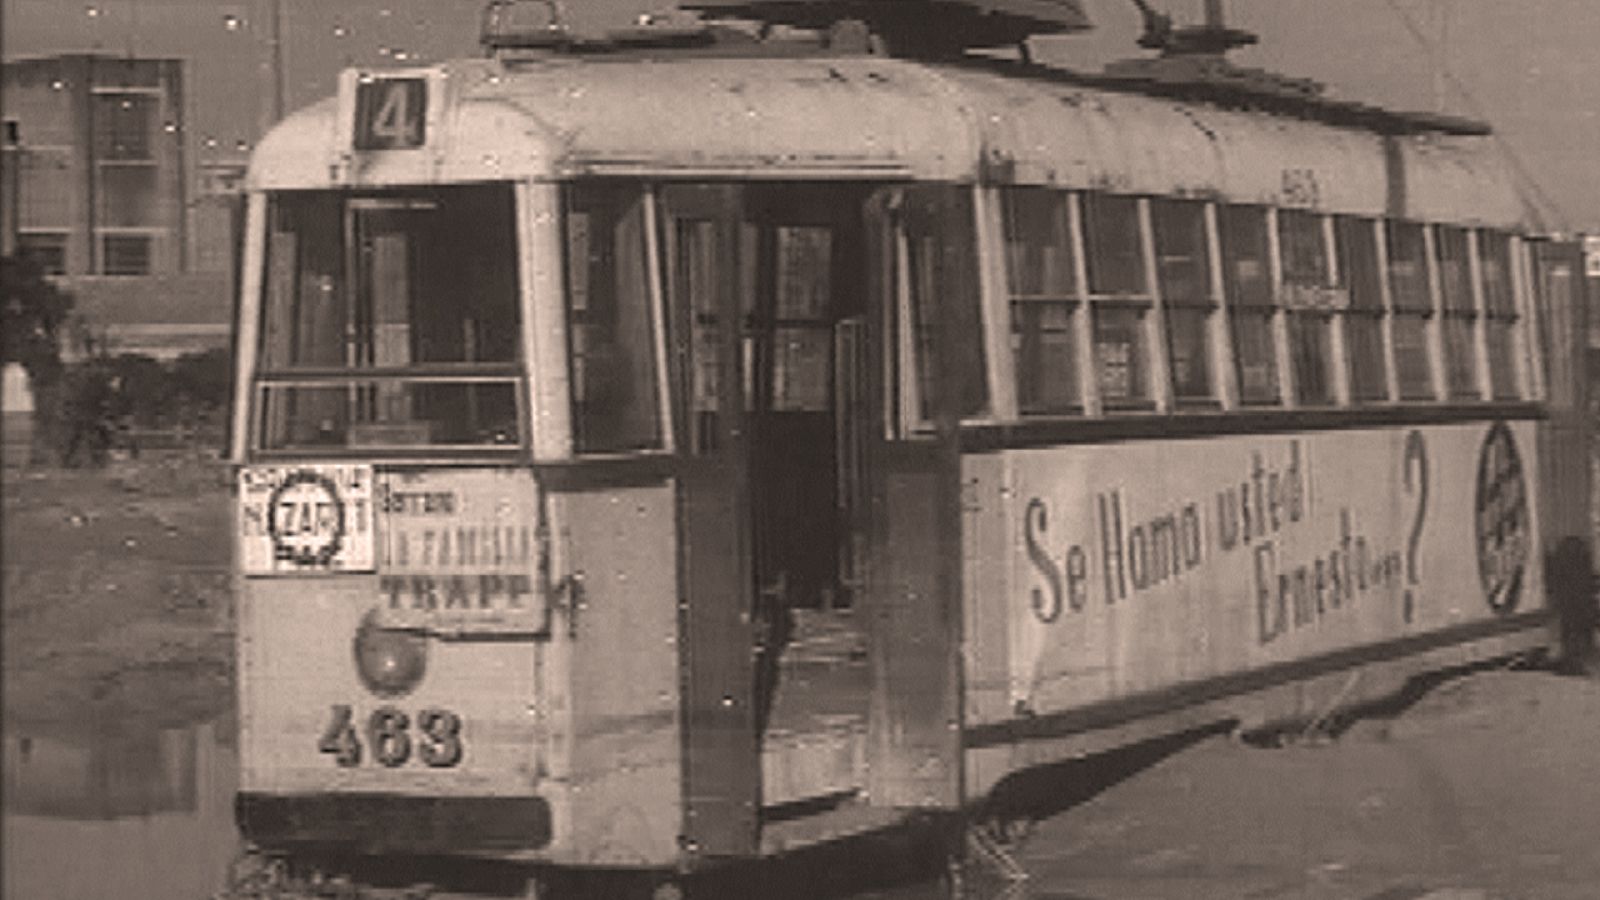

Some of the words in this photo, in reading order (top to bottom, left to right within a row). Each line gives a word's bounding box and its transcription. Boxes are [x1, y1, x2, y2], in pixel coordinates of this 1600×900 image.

[372, 82, 418, 147] 4
[1024, 497, 1087, 624] Se
[1098, 486, 1202, 605] llama
[1216, 438, 1306, 552] usted
[317, 704, 464, 769] 463
